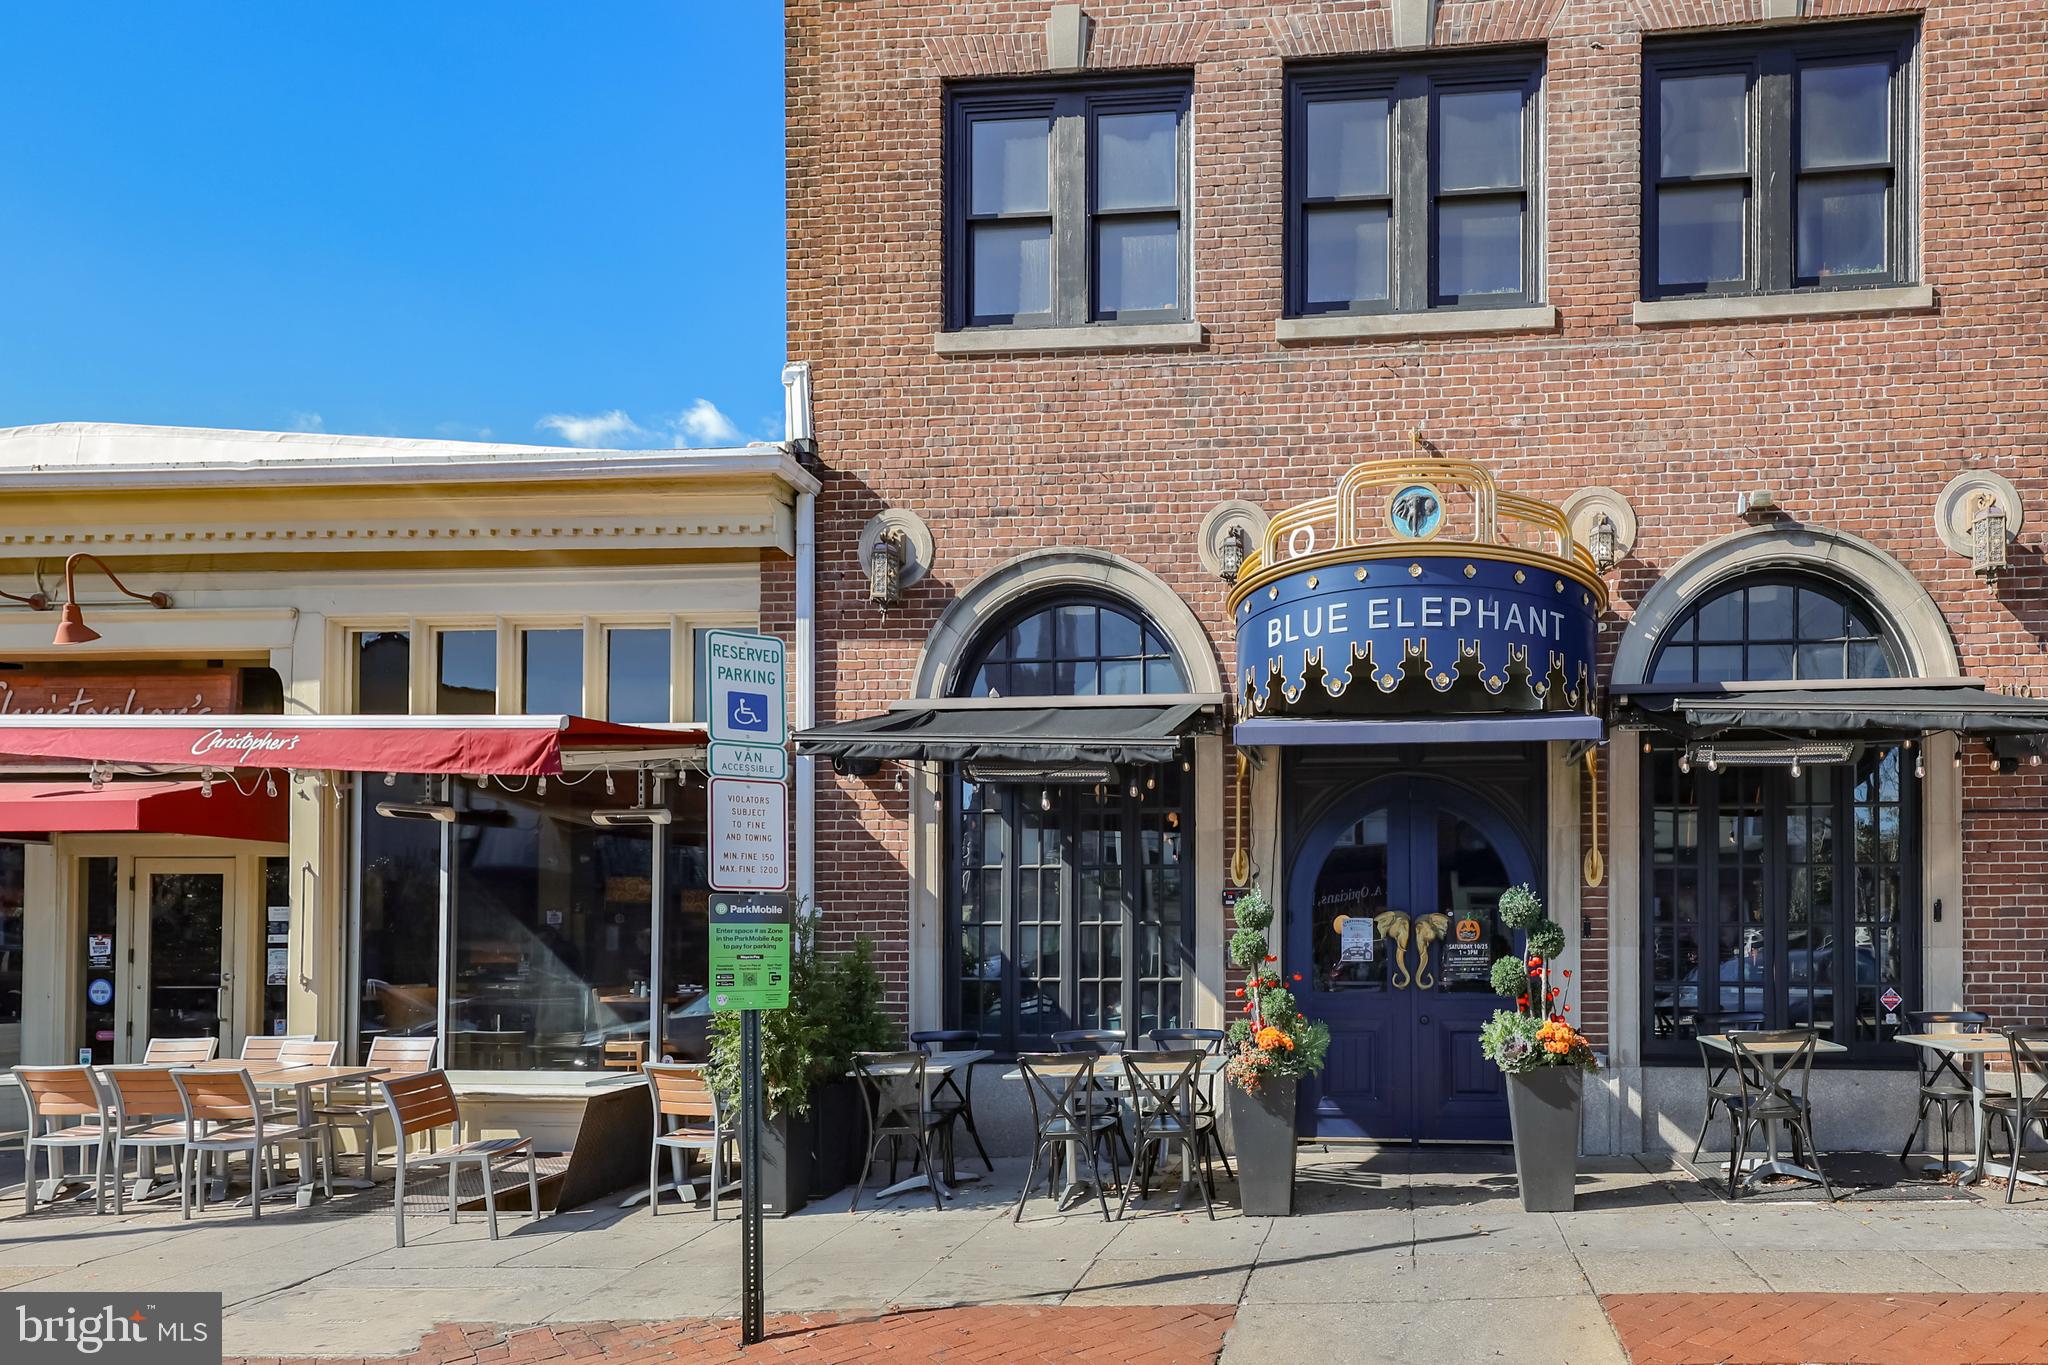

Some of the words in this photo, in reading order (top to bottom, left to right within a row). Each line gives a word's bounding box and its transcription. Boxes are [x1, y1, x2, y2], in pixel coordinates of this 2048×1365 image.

[1267, 602, 1349, 648] BLUE
[1368, 596, 1565, 641] ELEPHANT
[713, 643, 780, 664] RESERVED
[718, 666, 776, 685] PARKING
[191, 728, 300, 763] Christopher's
[734, 750, 762, 763] VAN
[721, 762, 775, 774] ACCESSIBLE
[728, 794, 770, 804] VIOLATORS
[731, 807, 766, 817] SUBJECT
[733, 820, 742, 828] TO
[747, 821, 766, 830] FINE
[726, 833, 741, 841] AND
[745, 833, 772, 842] TOWING
[740, 852, 758, 861] FINE
[761, 852, 775, 861] $50
[738, 865, 756, 874] FINE
[760, 865, 779, 874] $200
[730, 905, 783, 914] ParkMobile
[734, 927, 754, 935] space
[770, 935, 784, 943] App
